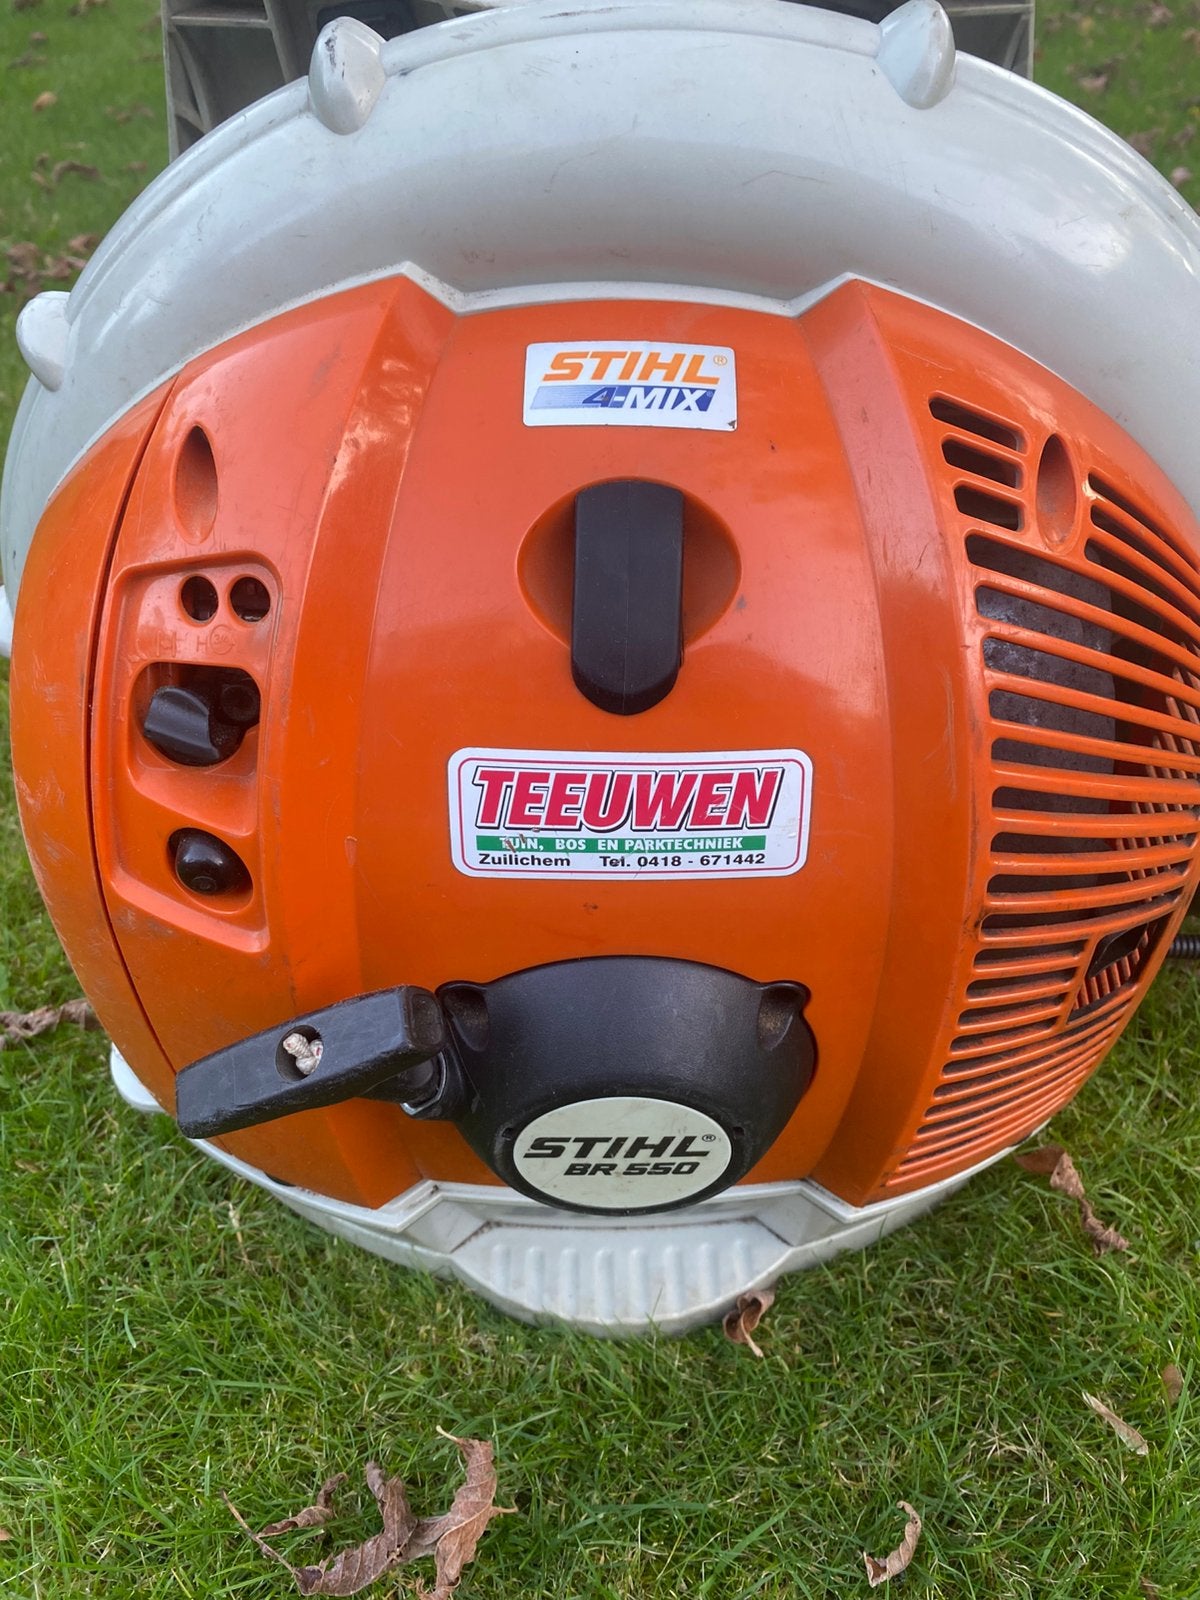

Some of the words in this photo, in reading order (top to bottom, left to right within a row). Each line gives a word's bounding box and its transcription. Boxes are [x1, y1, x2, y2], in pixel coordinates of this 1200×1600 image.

[582, 386, 706, 411] 4-MIX
[472, 766, 785, 833] TEEUWEN
[555, 839, 587, 850] BOS
[597, 839, 618, 850] EN
[624, 837, 743, 850] PARKTECHNIEK
[478, 853, 571, 866] Zuilichem
[637, 855, 682, 867] 0418
[700, 853, 766, 866] 671442
[563, 1163, 618, 1176] BR
[622, 1161, 700, 1176] 550
